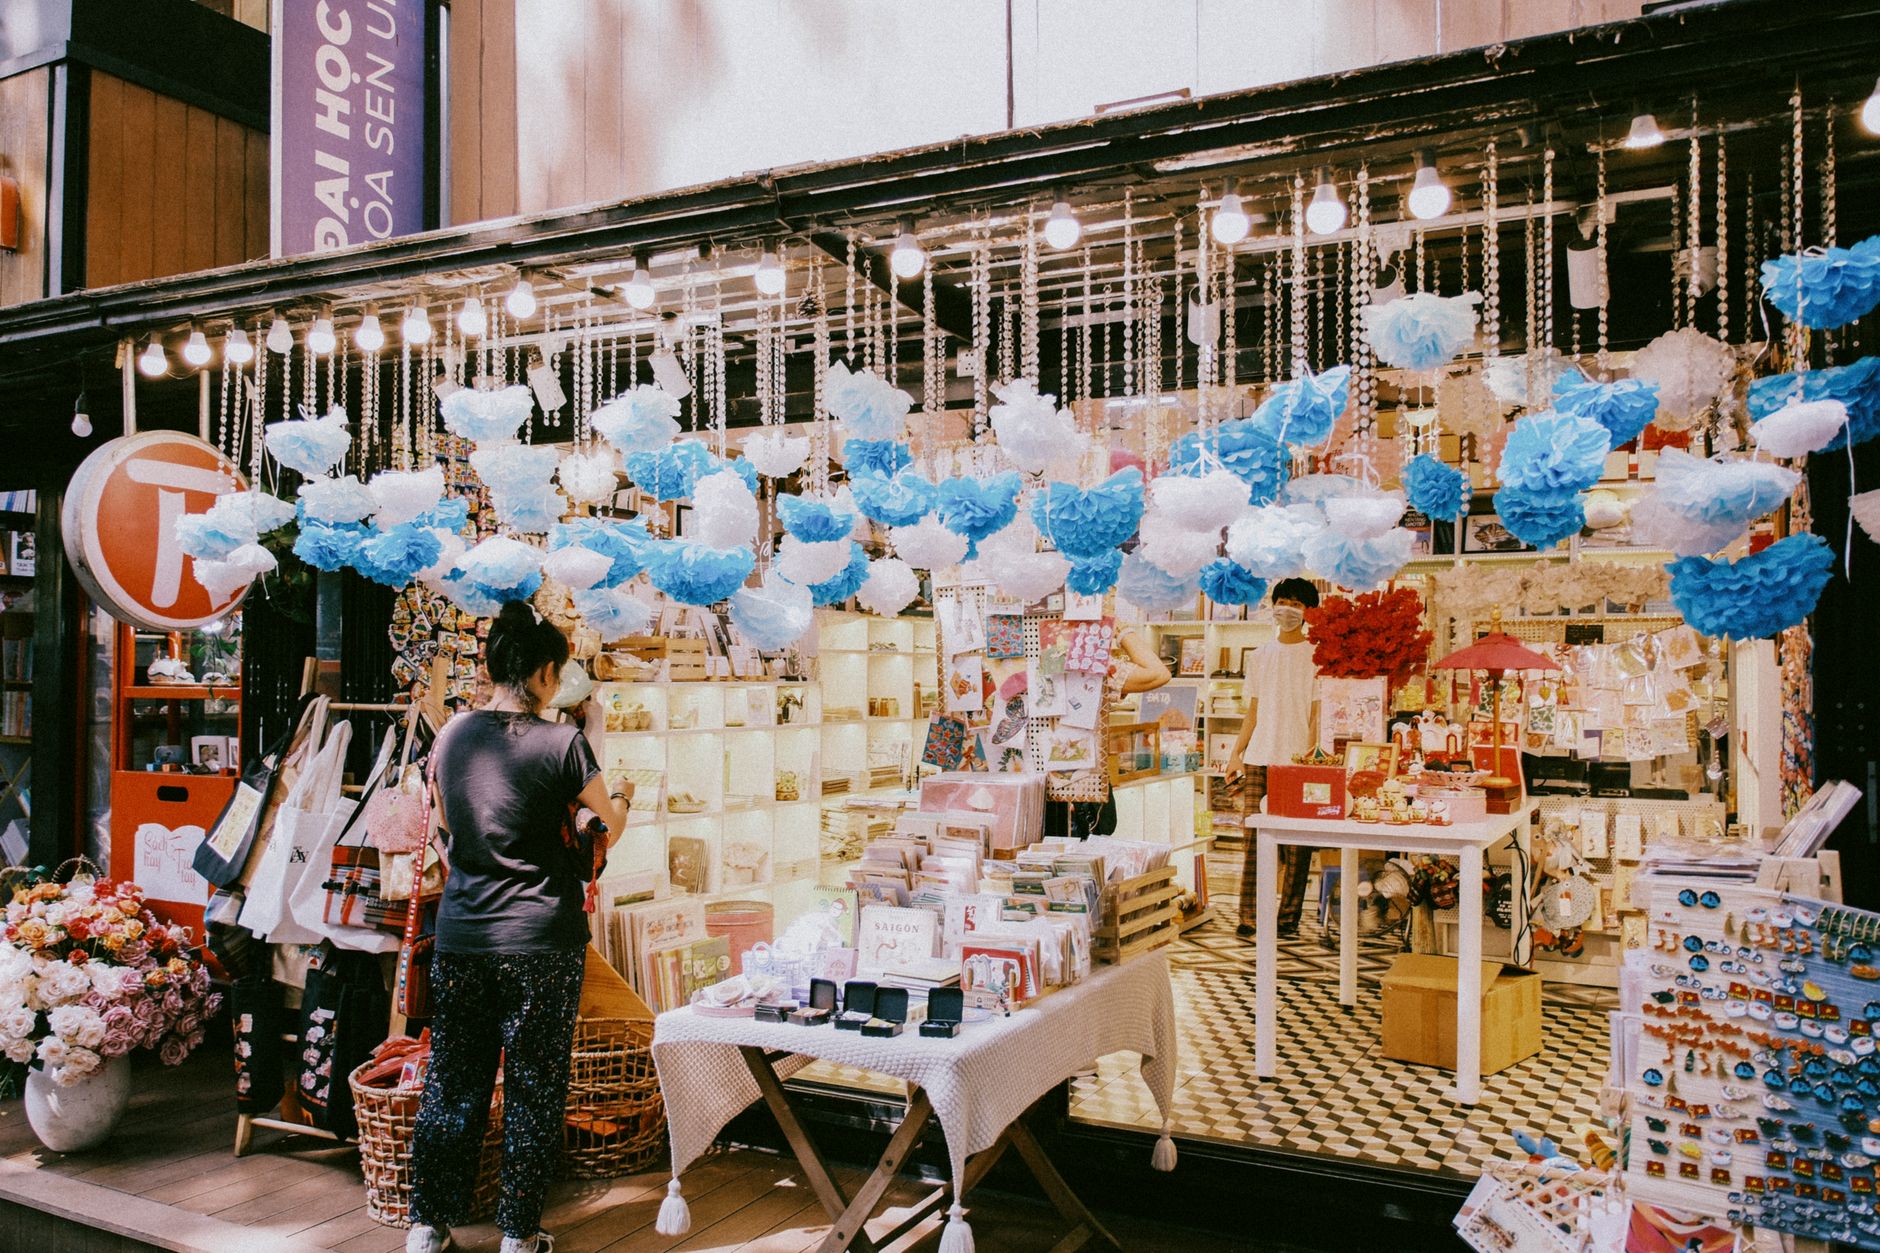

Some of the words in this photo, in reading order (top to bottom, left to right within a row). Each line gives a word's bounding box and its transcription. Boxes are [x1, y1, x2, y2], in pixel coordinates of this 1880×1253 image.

[315, 0, 361, 140] HỌC
[365, 52, 395, 156] SEN
[363, 170, 394, 244] OA
[874, 922, 920, 934] SAIGON
